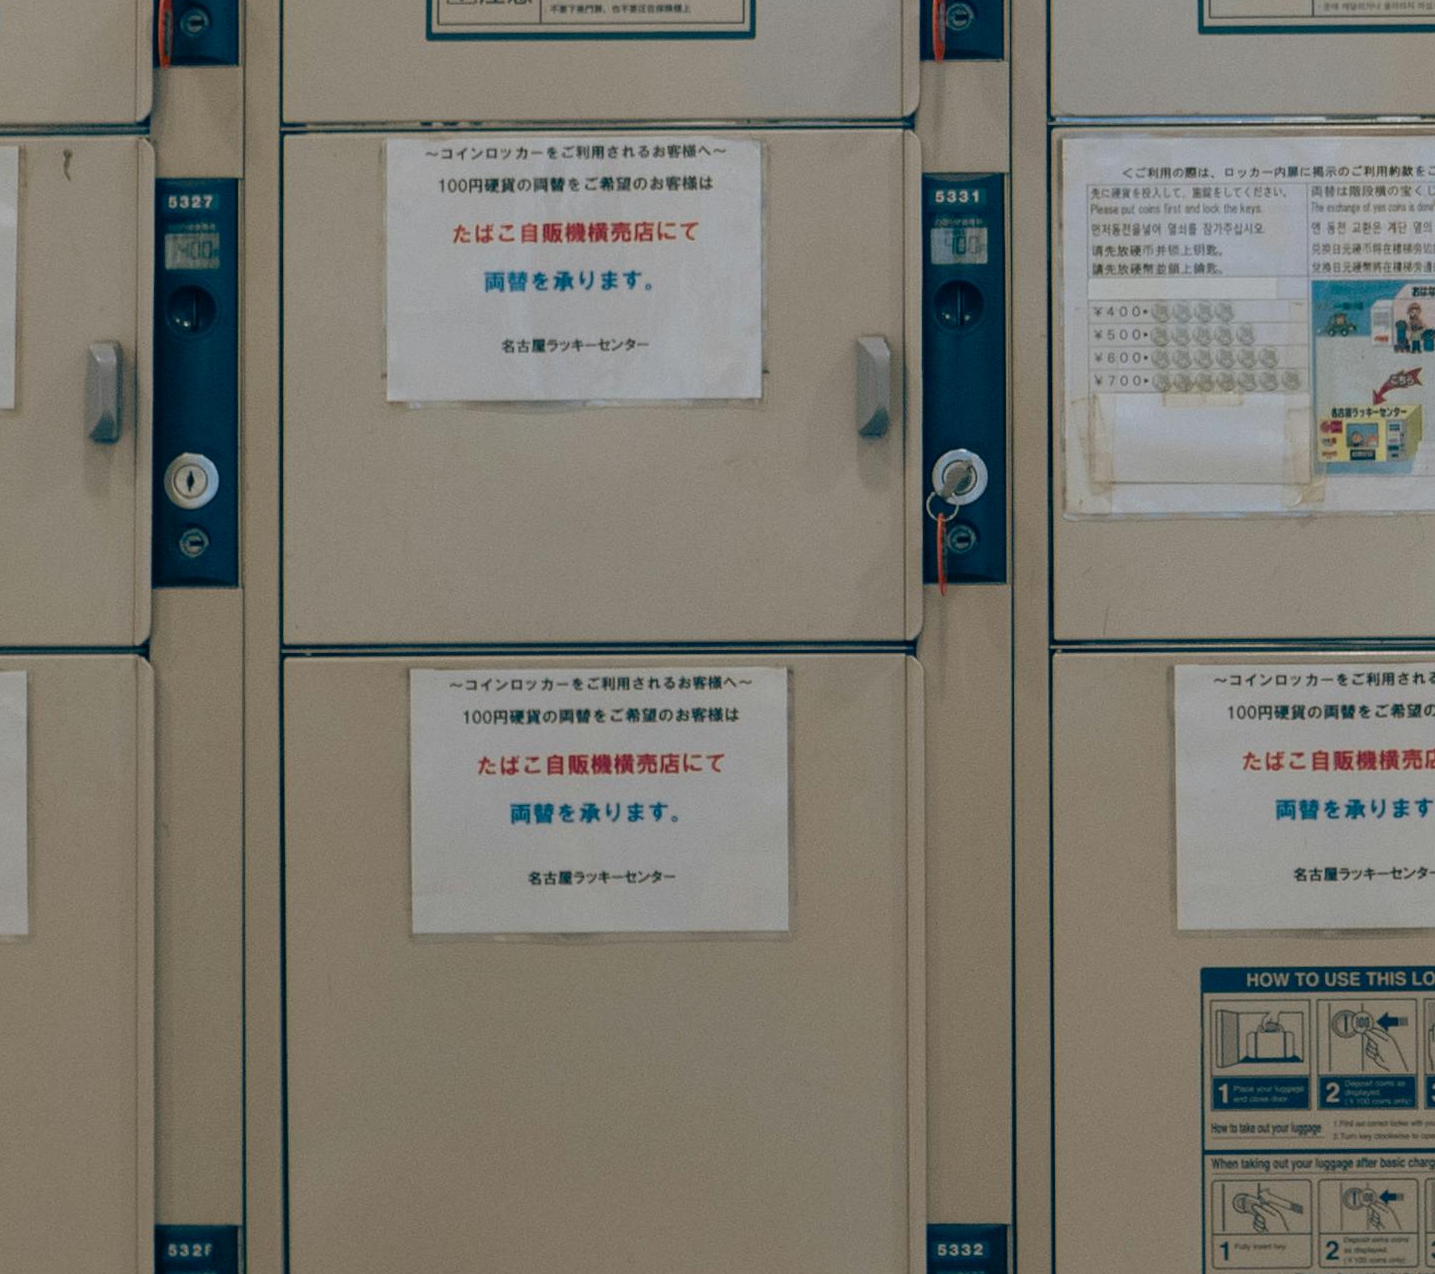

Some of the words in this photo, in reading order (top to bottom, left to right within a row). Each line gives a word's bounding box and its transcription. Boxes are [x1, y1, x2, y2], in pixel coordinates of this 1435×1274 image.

[439, 174, 714, 194] 100円硬貨の両替をご希望のお客様は
[168, 195, 213, 208] 5327
[936, 191, 980, 203] 5331
[452, 220, 700, 245] たばこ自販機横売店にて
[483, 269, 653, 294] 両替を承ります。
[501, 337, 649, 354] 名古屋ラッキーセンター
[477, 752, 725, 777] たばこ自販機横売店にて
[509, 800, 679, 826] 両替を承ります。
[528, 869, 676, 886] 名古屋ラッキーセンター
[1246, 972, 1288, 987] HOW
[1296, 972, 1319, 987] TO
[1324, 972, 1360, 987] USE
[1366, 971, 1406, 986] THIS
[937, 1244, 983, 1256] 5332
